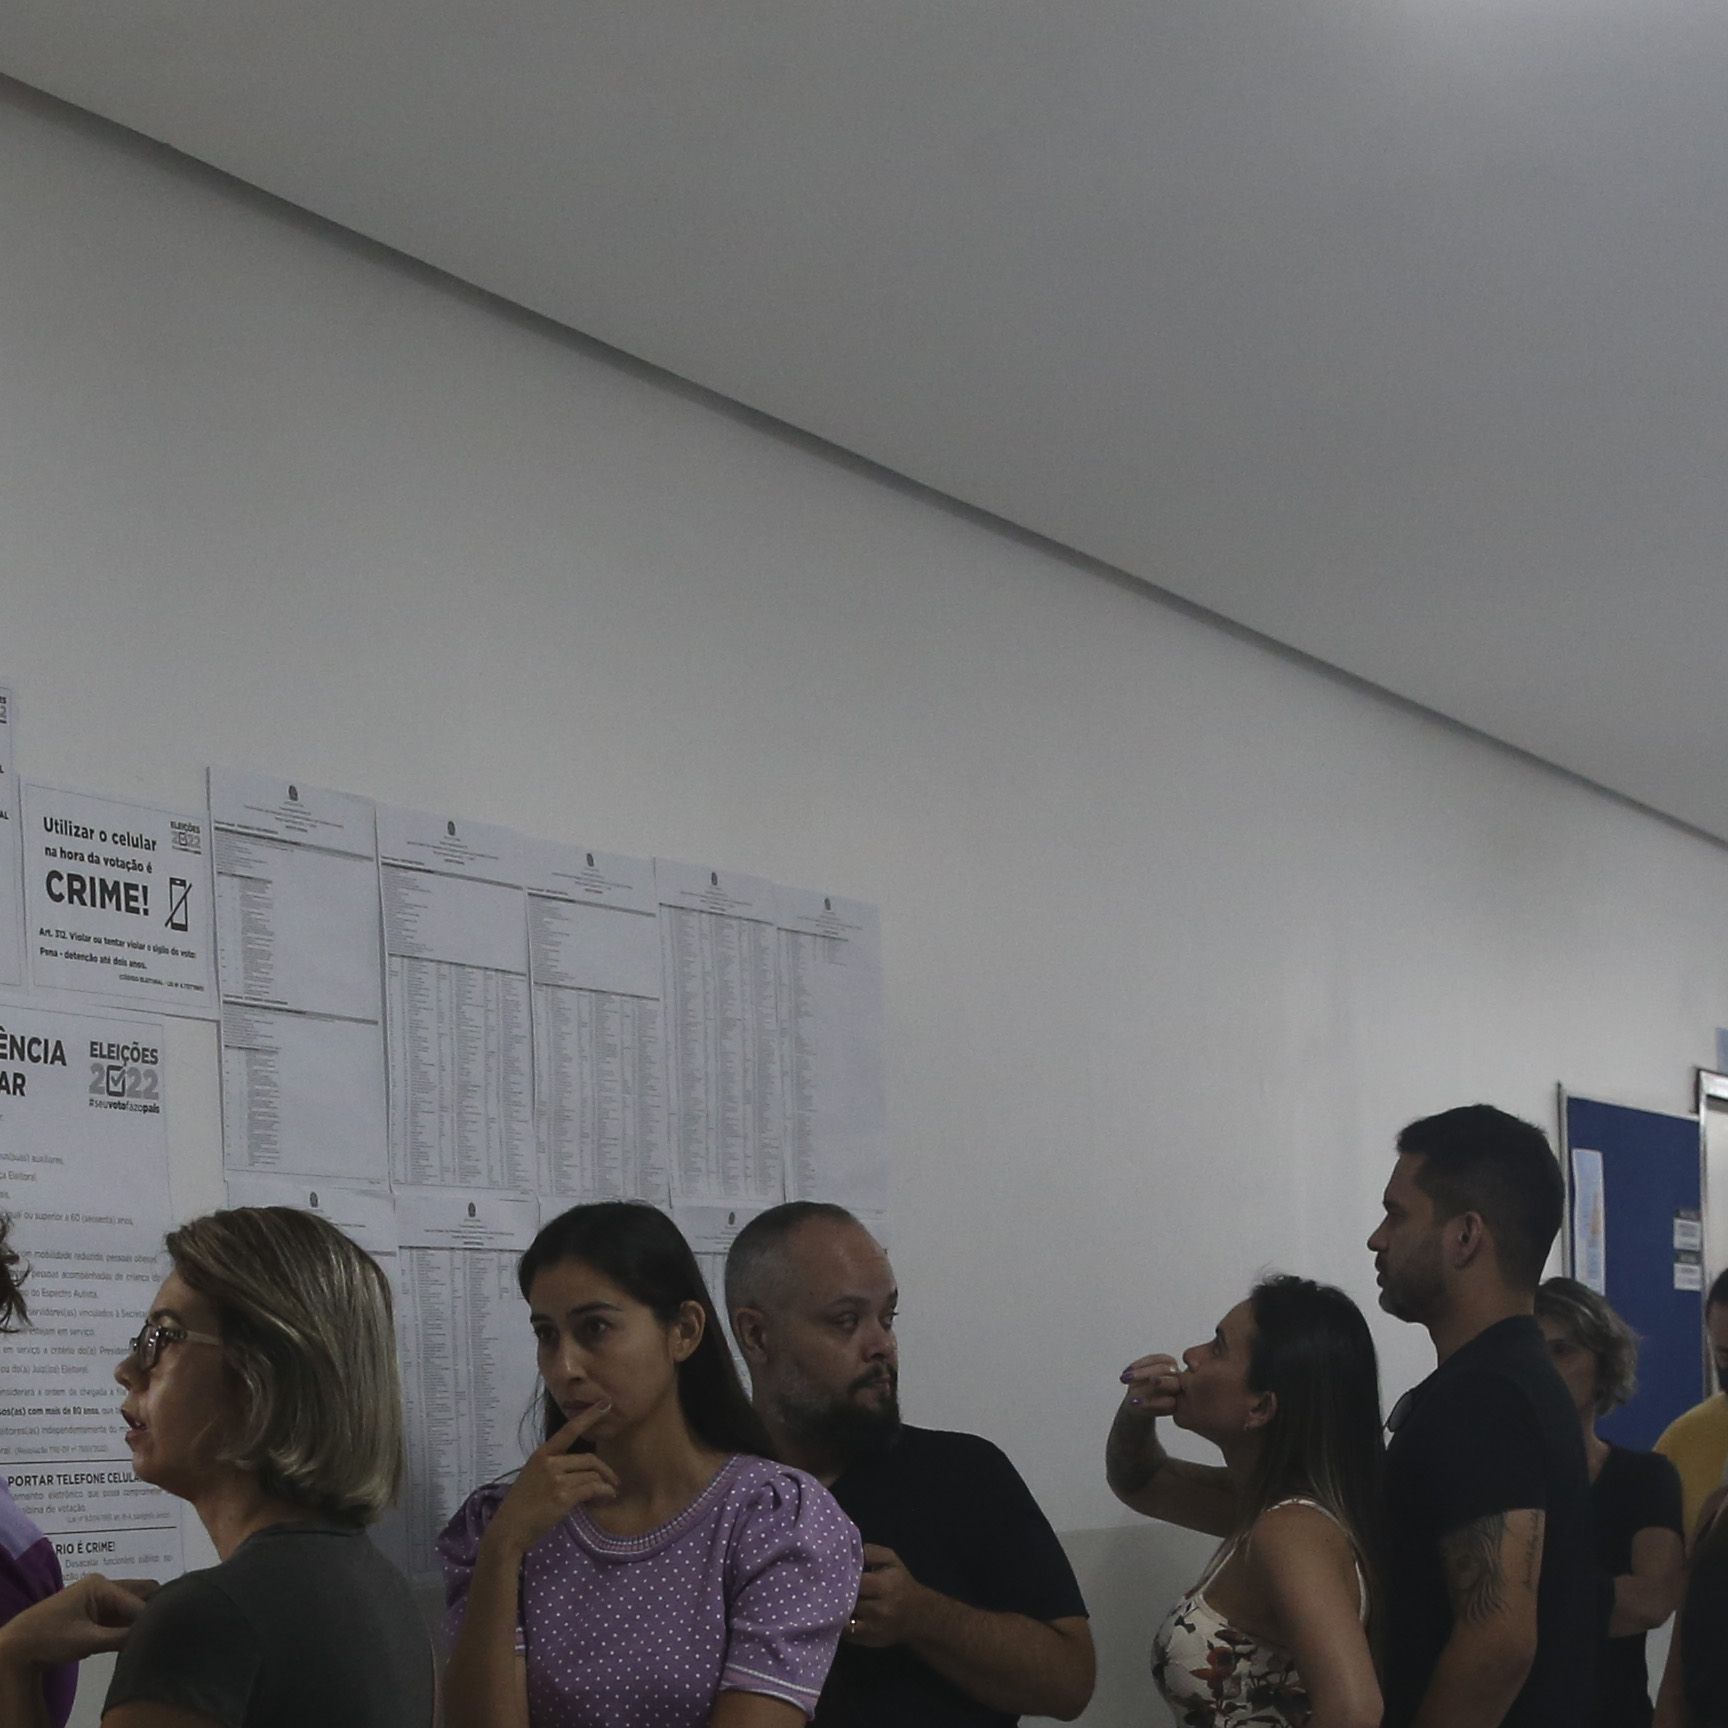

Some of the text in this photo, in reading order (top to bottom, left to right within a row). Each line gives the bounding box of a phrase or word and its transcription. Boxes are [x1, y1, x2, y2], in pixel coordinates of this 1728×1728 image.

[44, 817, 94, 839] Utilizar
[99, 831, 107, 842] o
[112, 832, 156, 851] celular
[170, 821, 200, 833] ELEIÇÕES
[45, 847, 152, 873] na hora da votação é
[46, 870, 148, 916] CRIME!
[90, 1041, 158, 1066] ELEIÇÕES
[8, 1475, 53, 1486] PORTAR
[57, 1473, 105, 1485] TELEFONE
[56, 1540, 115, 1554] RIO É CRIME!
